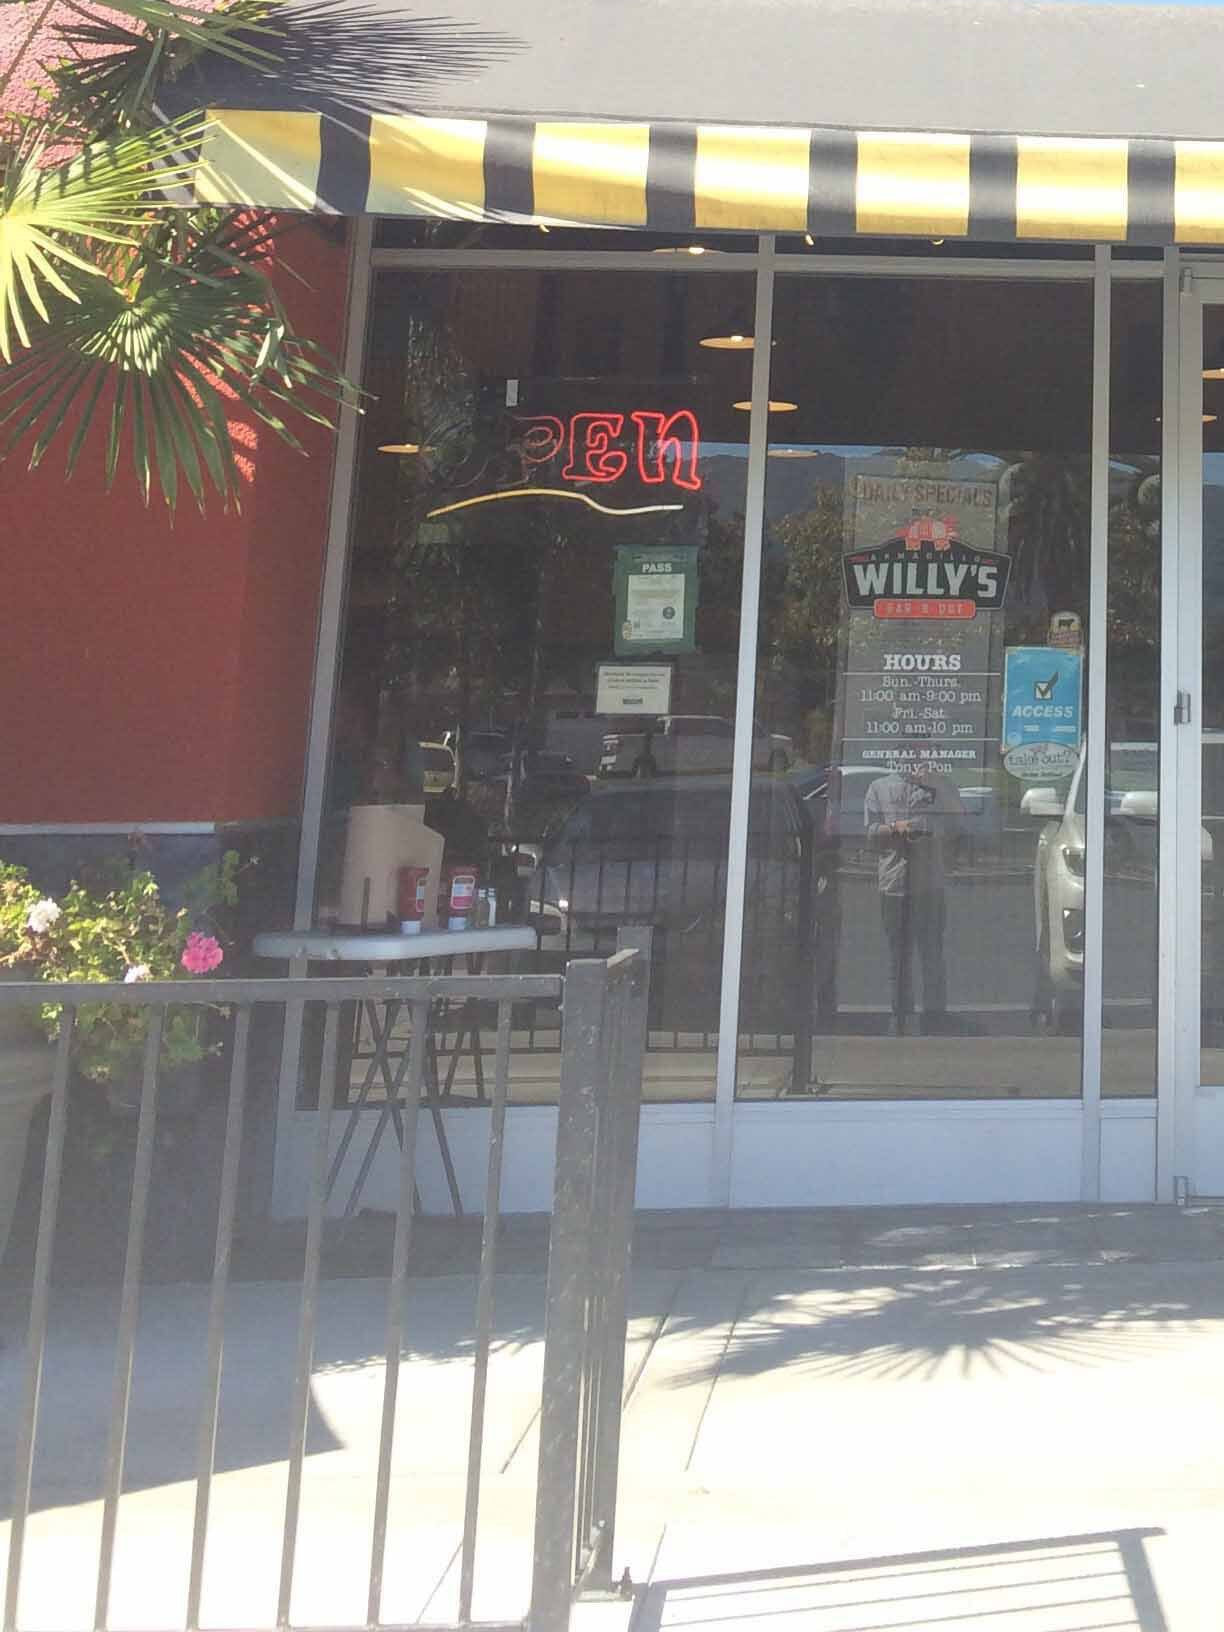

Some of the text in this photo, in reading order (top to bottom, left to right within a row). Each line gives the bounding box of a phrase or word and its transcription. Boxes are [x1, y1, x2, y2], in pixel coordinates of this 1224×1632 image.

[641, 563, 673, 573] PASS
[853, 562, 998, 598] WILLY'S
[883, 654, 961, 671] HOURS
[860, 689, 894, 702] 11:00
[960, 691, 982, 704] pm
[1011, 705, 1073, 718] ACCESS
[866, 721, 899, 734] 11:00
[951, 723, 974, 735] pm
[861, 750, 977, 759] GENERAL MANAGER
